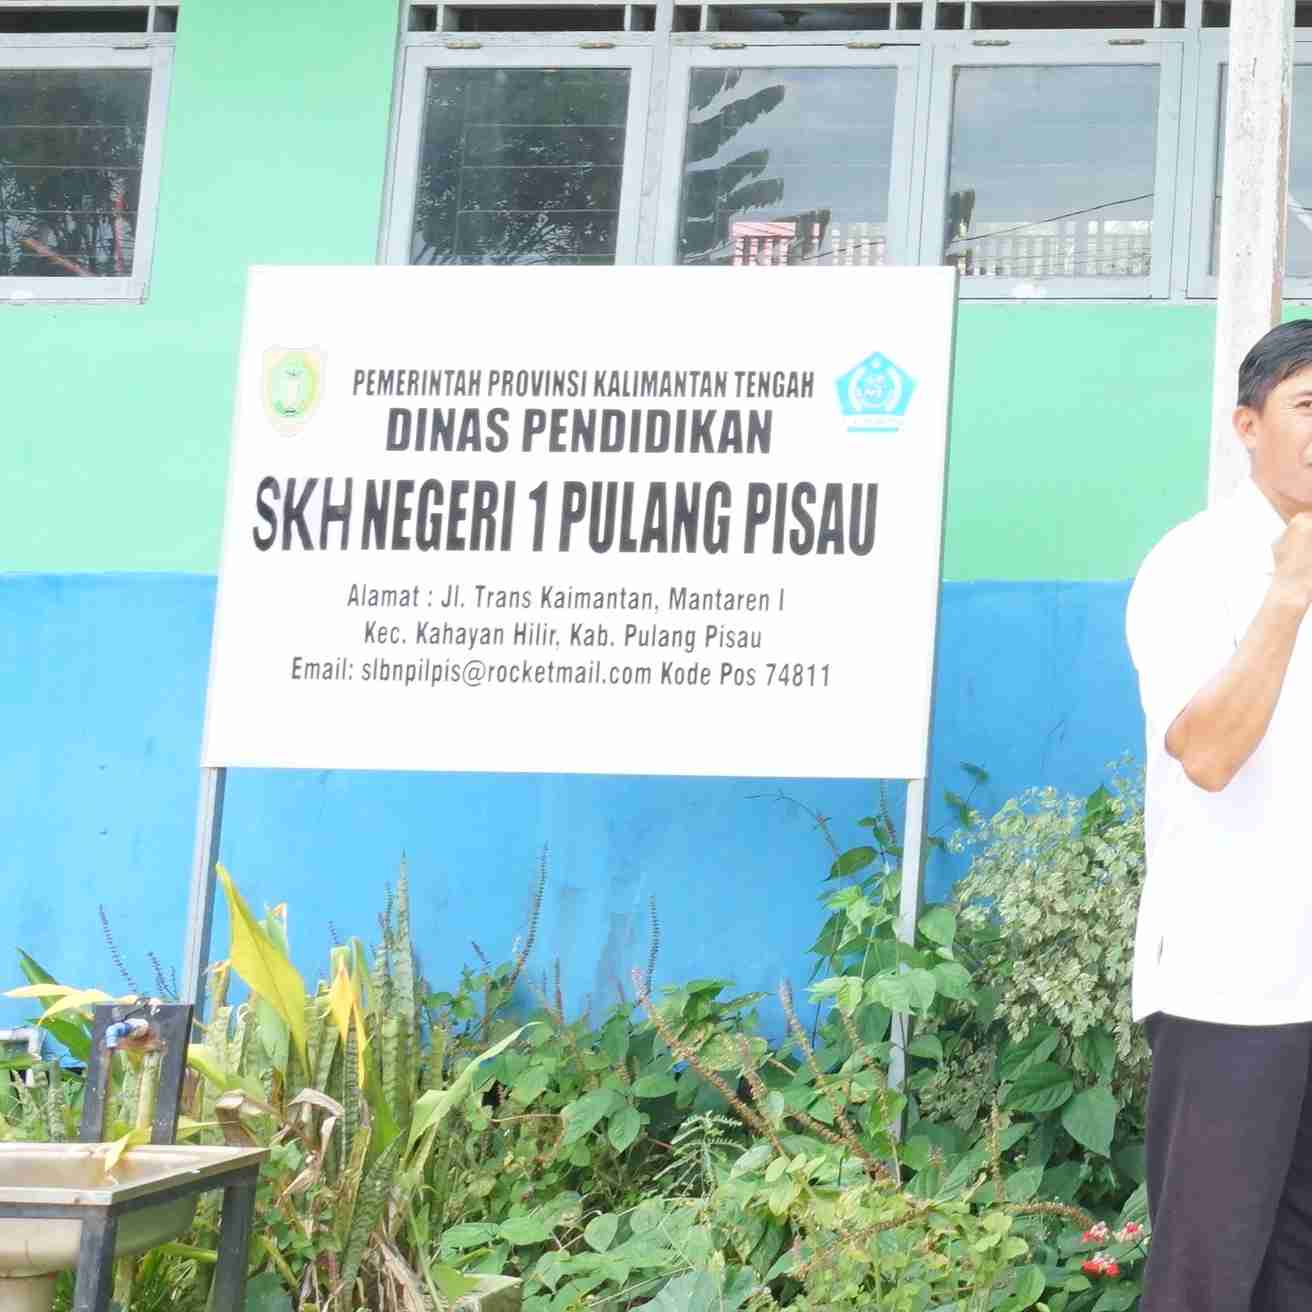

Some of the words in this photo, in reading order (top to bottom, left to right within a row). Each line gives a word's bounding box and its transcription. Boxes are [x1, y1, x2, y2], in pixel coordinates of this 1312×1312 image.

[353, 369, 481, 396] PEMERINTAH
[488, 370, 587, 397] PROVINSI
[594, 370, 727, 397] KALIMANTAN
[734, 371, 814, 398] TENGAH
[386, 408, 509, 453] DINAS
[522, 409, 772, 454] PENDIDIKAN
[253, 476, 353, 552] SKH
[361, 479, 516, 552] NEGERI
[529, 481, 548, 552] 1
[559, 481, 731, 554] PULANG
[744, 482, 878, 556] PISAU
[347, 584, 419, 607] Alamat
[441, 585, 464, 608] Jl.
[476, 585, 531, 608] Trans
[541, 586, 658, 613] Kaimantan,
[669, 587, 769, 611] Mantaren
[365, 621, 405, 644] Kec.
[416, 622, 504, 651] Kahayan
[570, 624, 614, 646] Kab.
[625, 624, 696, 653] Pulang
[705, 625, 761, 648] Pisau
[292, 656, 353, 680] Email:
[362, 658, 651, 687] slbnpilpis@rocketmail.com
[661, 662, 711, 685] Kode
[720, 662, 756, 686] Pos
[766, 663, 829, 686] 74811
